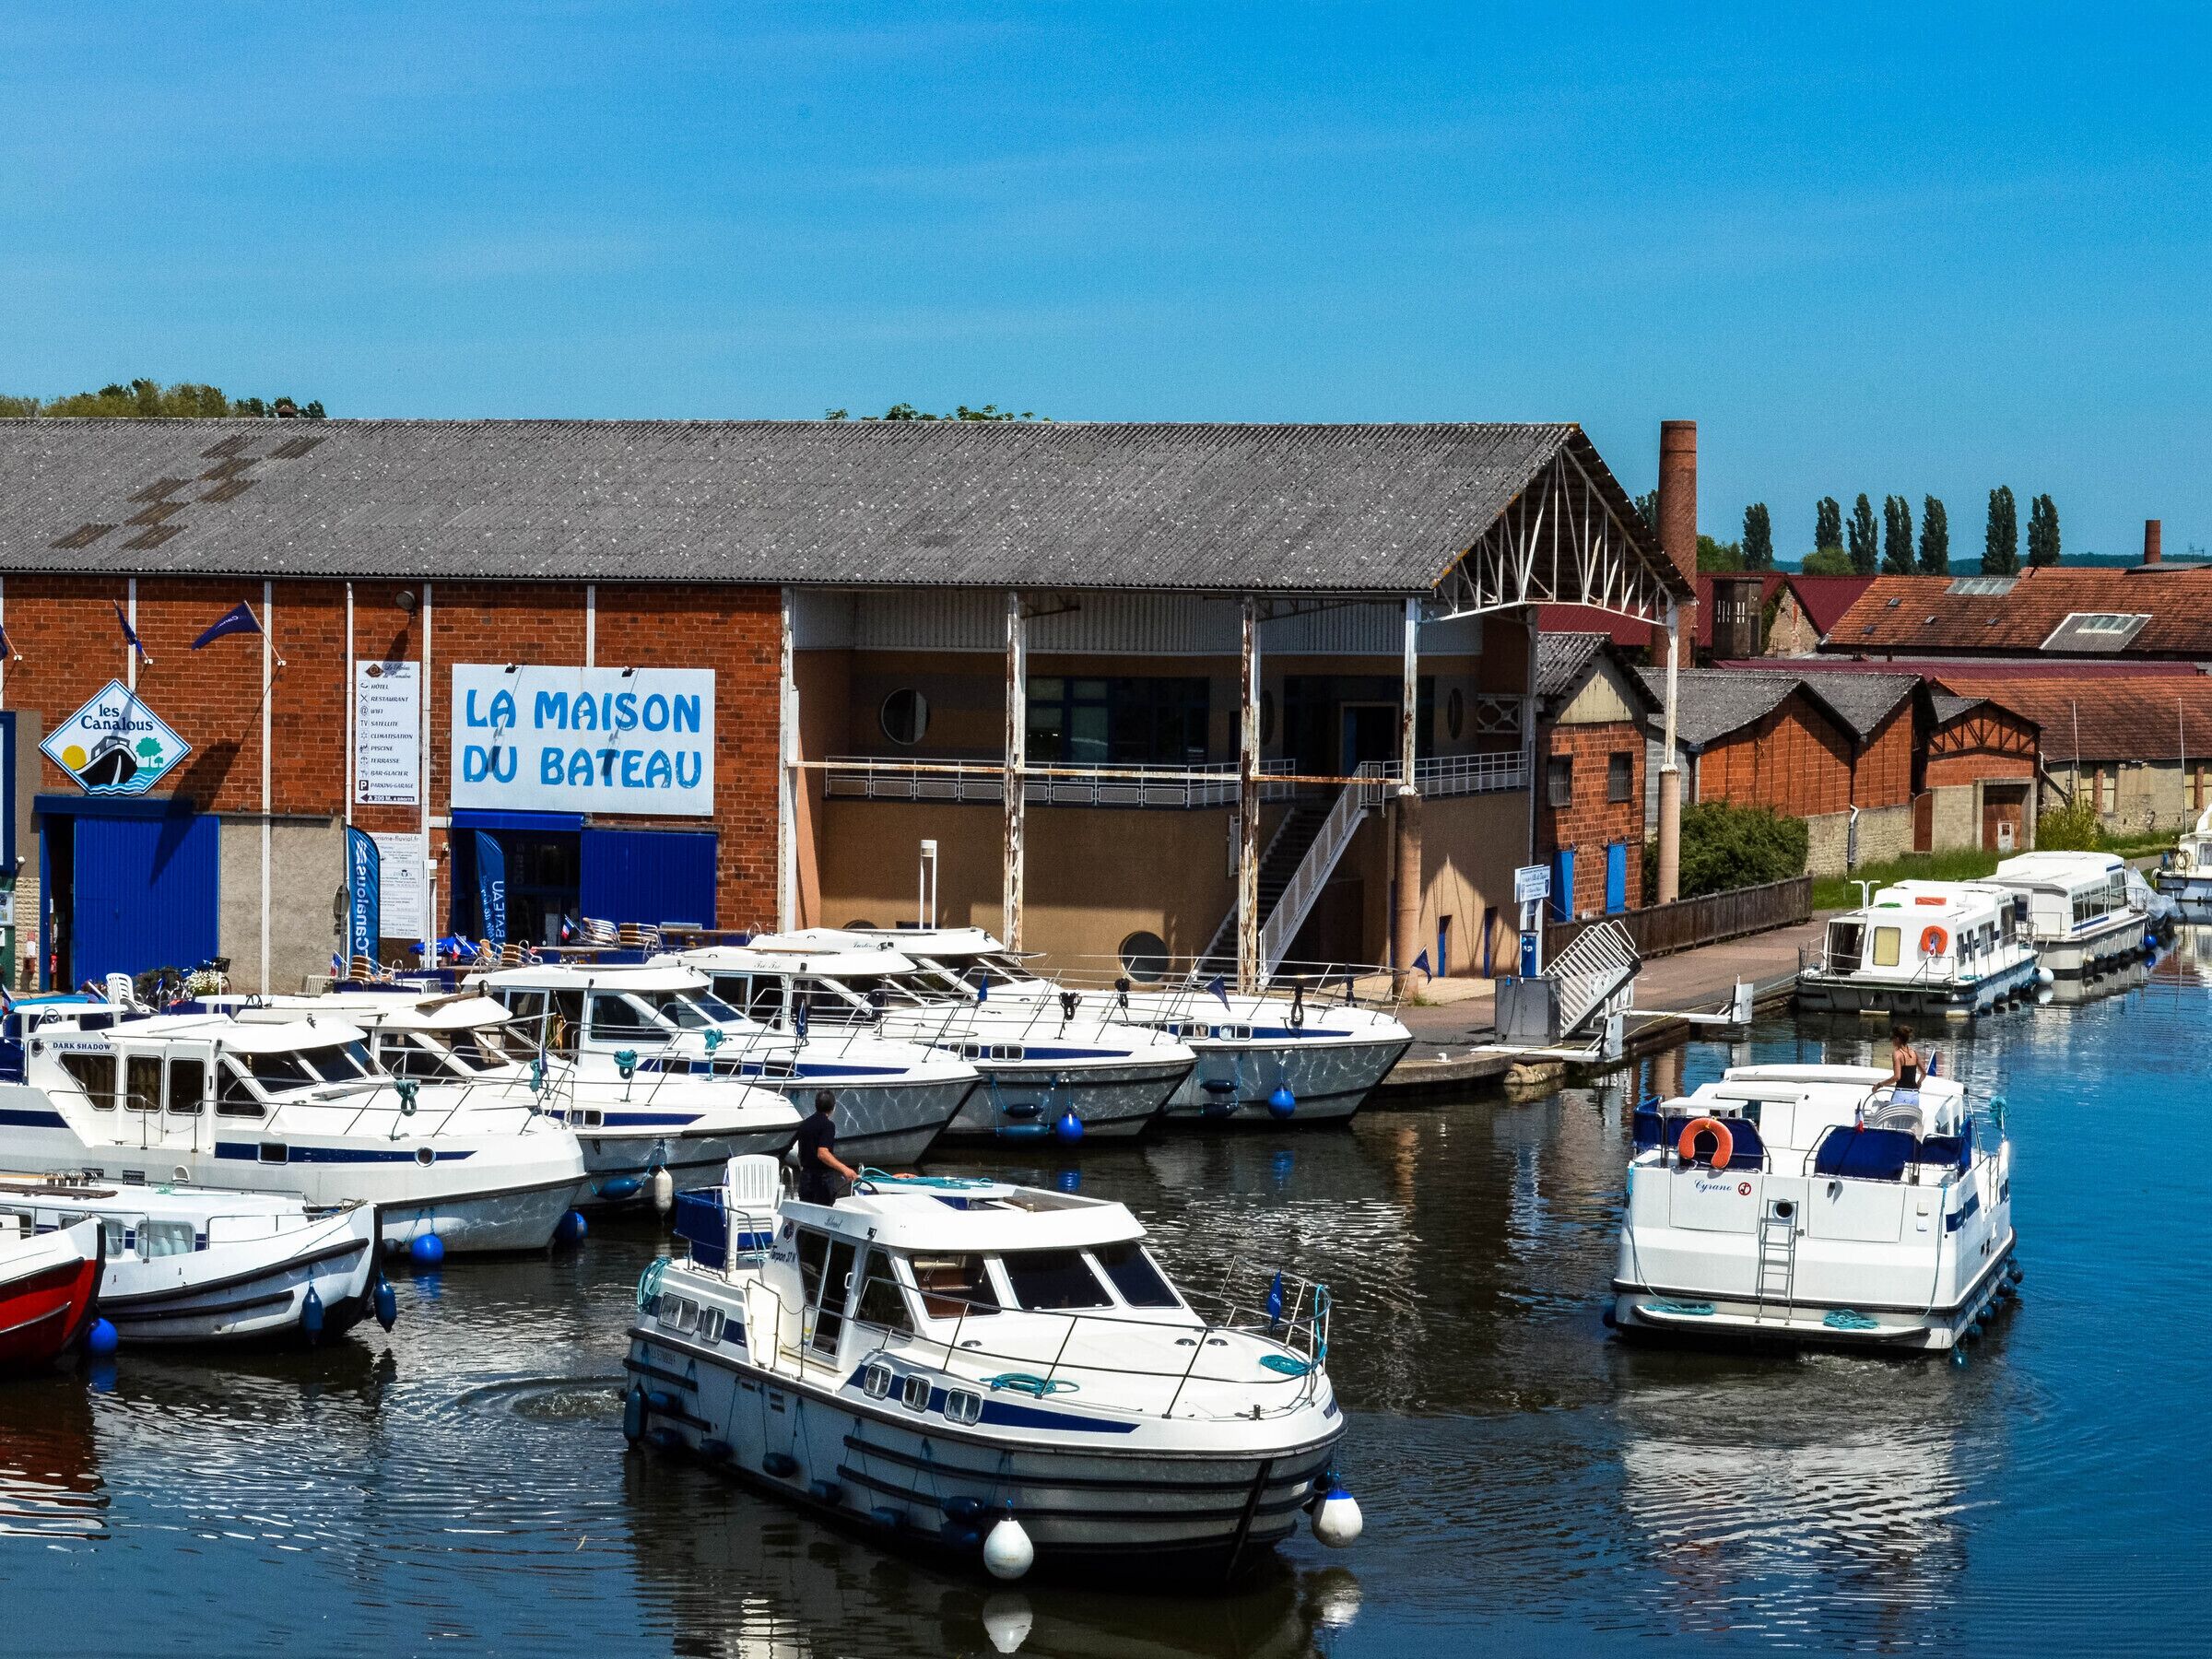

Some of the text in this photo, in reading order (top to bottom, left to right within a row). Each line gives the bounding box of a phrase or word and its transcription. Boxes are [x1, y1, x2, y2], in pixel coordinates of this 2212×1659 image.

[99, 703, 120, 717] les
[466, 689, 700, 733] LA MAISON
[80, 715, 154, 731] Canalous
[463, 745, 701, 789] DU BATEAU
[1694, 1179, 1732, 1194] Cyrano
[769, 1245, 786, 1263] Tarpon
